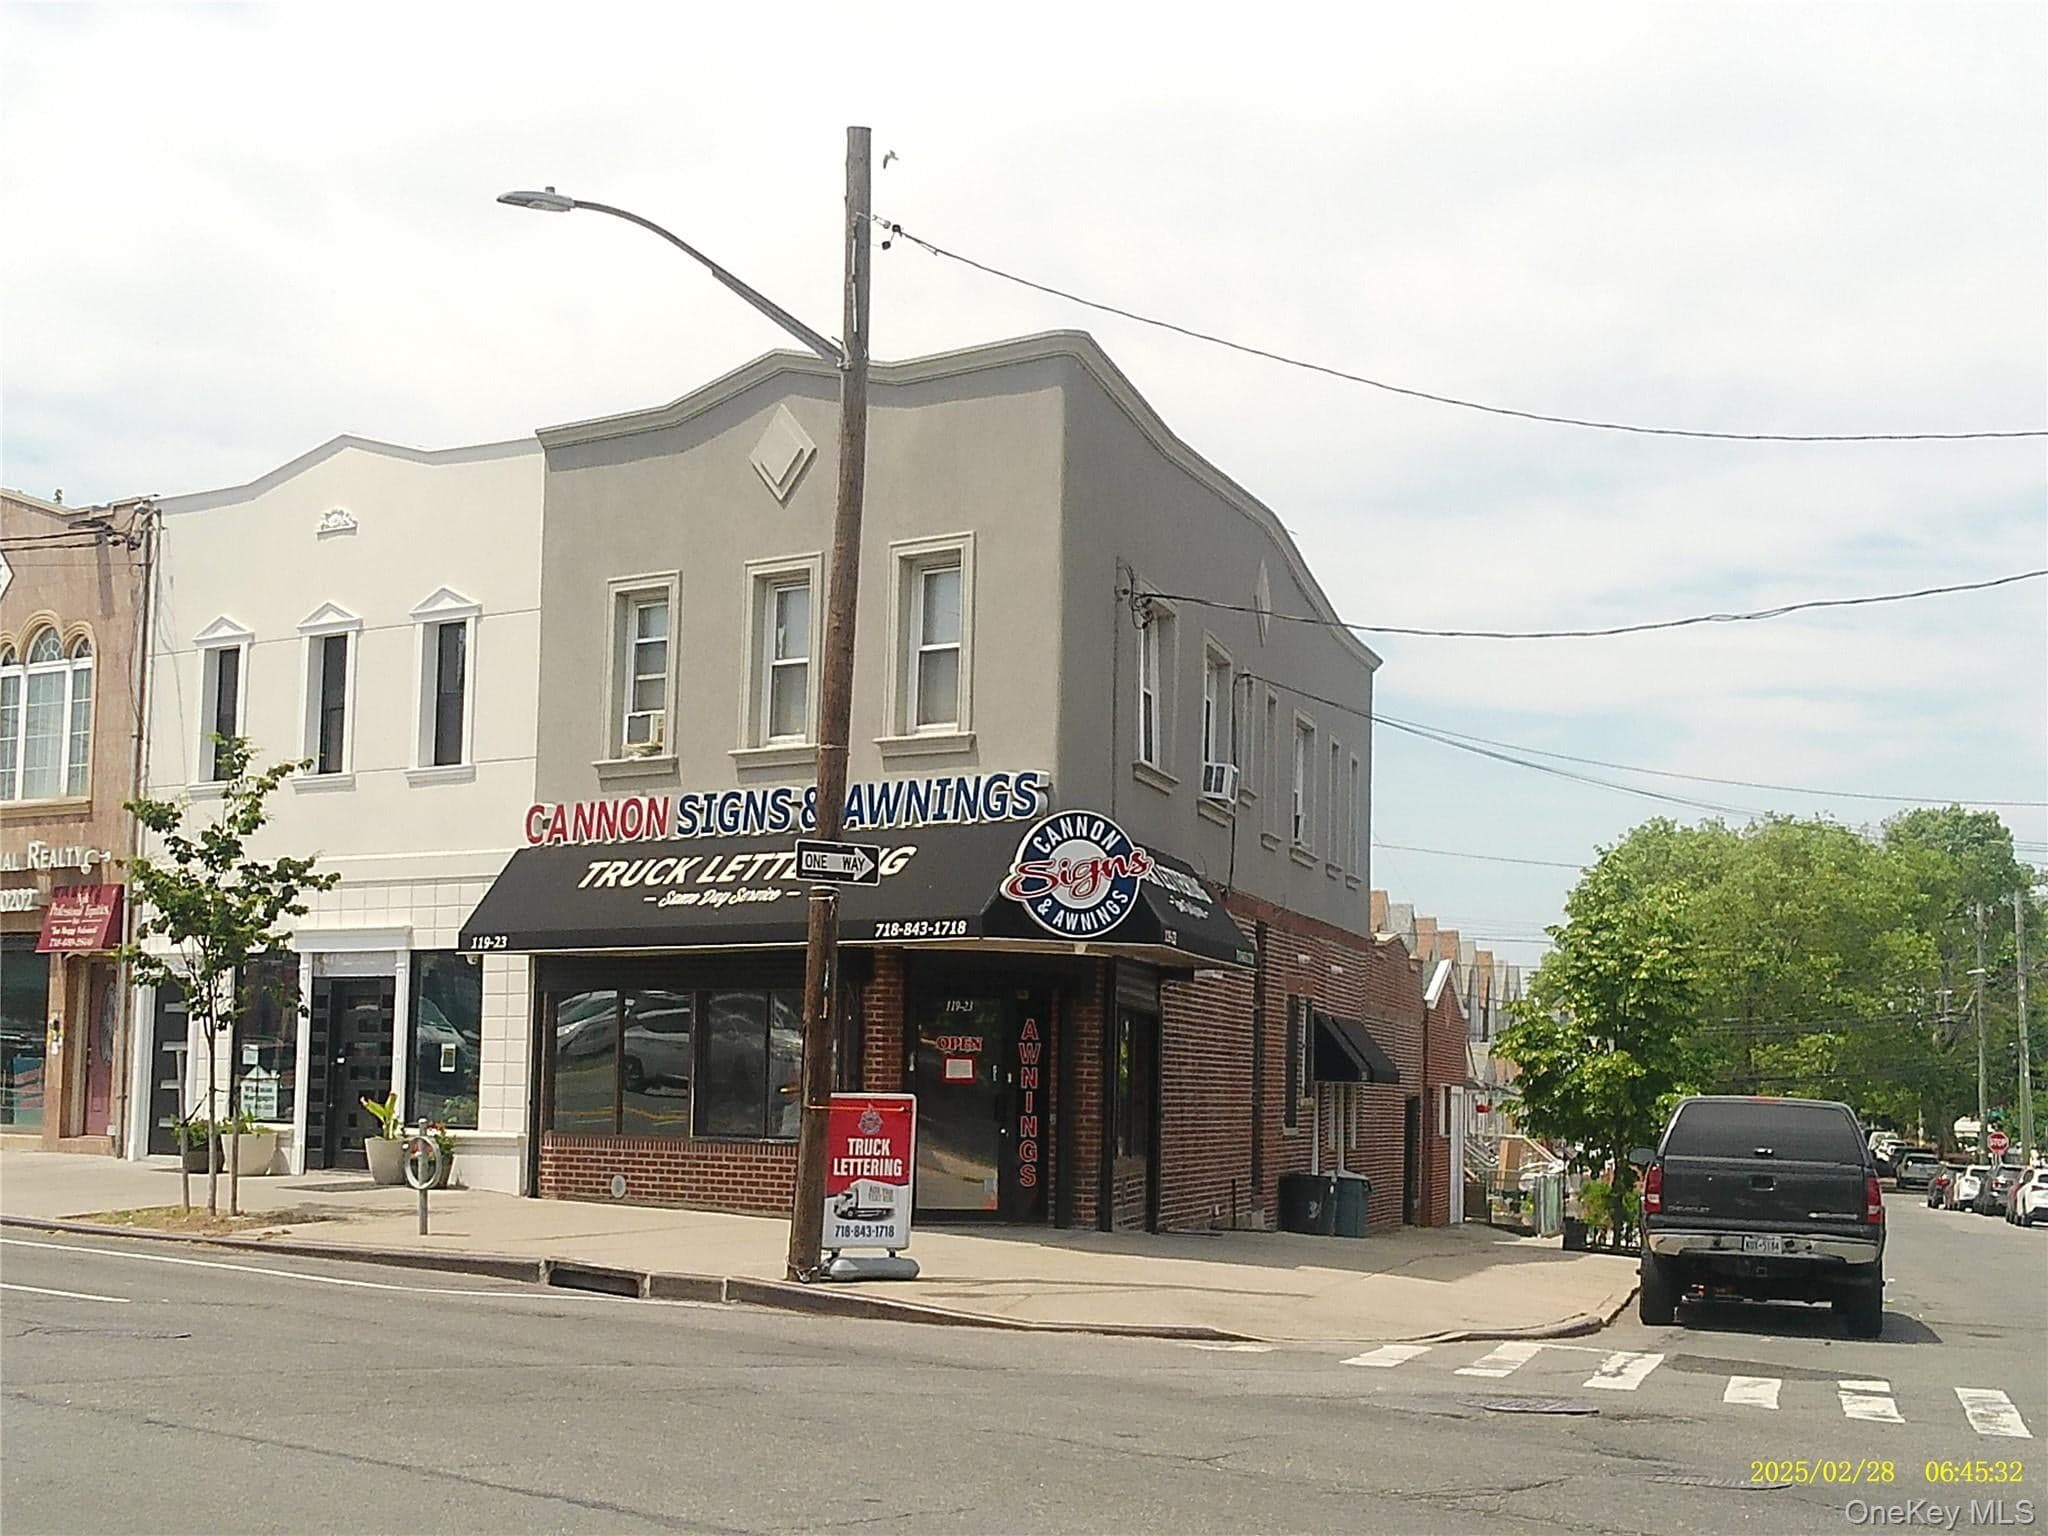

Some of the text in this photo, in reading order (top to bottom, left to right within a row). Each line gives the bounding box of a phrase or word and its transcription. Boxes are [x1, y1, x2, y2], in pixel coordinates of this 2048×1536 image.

[525, 772, 1039, 844] CANNON SIGNS & AWNINGS
[1033, 816, 1122, 854] CANNON
[577, 846, 918, 889] TRUCK LETTEG
[805, 853, 866, 872] ONE WAY
[1006, 850, 1152, 899] Signs
[658, 887, 782, 908] Same Day Service
[1037, 890, 1129, 932] & AWNINGS
[875, 920, 967, 938] 718-843-1718
[471, 935, 508, 950] 119-23
[946, 1000, 974, 1012] 119-23
[936, 1036, 983, 1052] OPEN
[1018, 1018, 1041, 1187] AWNINGS
[847, 1138, 891, 1156] TRUCK
[1989, 1138, 2007, 1148] STOP
[833, 1158, 903, 1177] LETTERING
[835, 1225, 895, 1239] 718-843-1718
